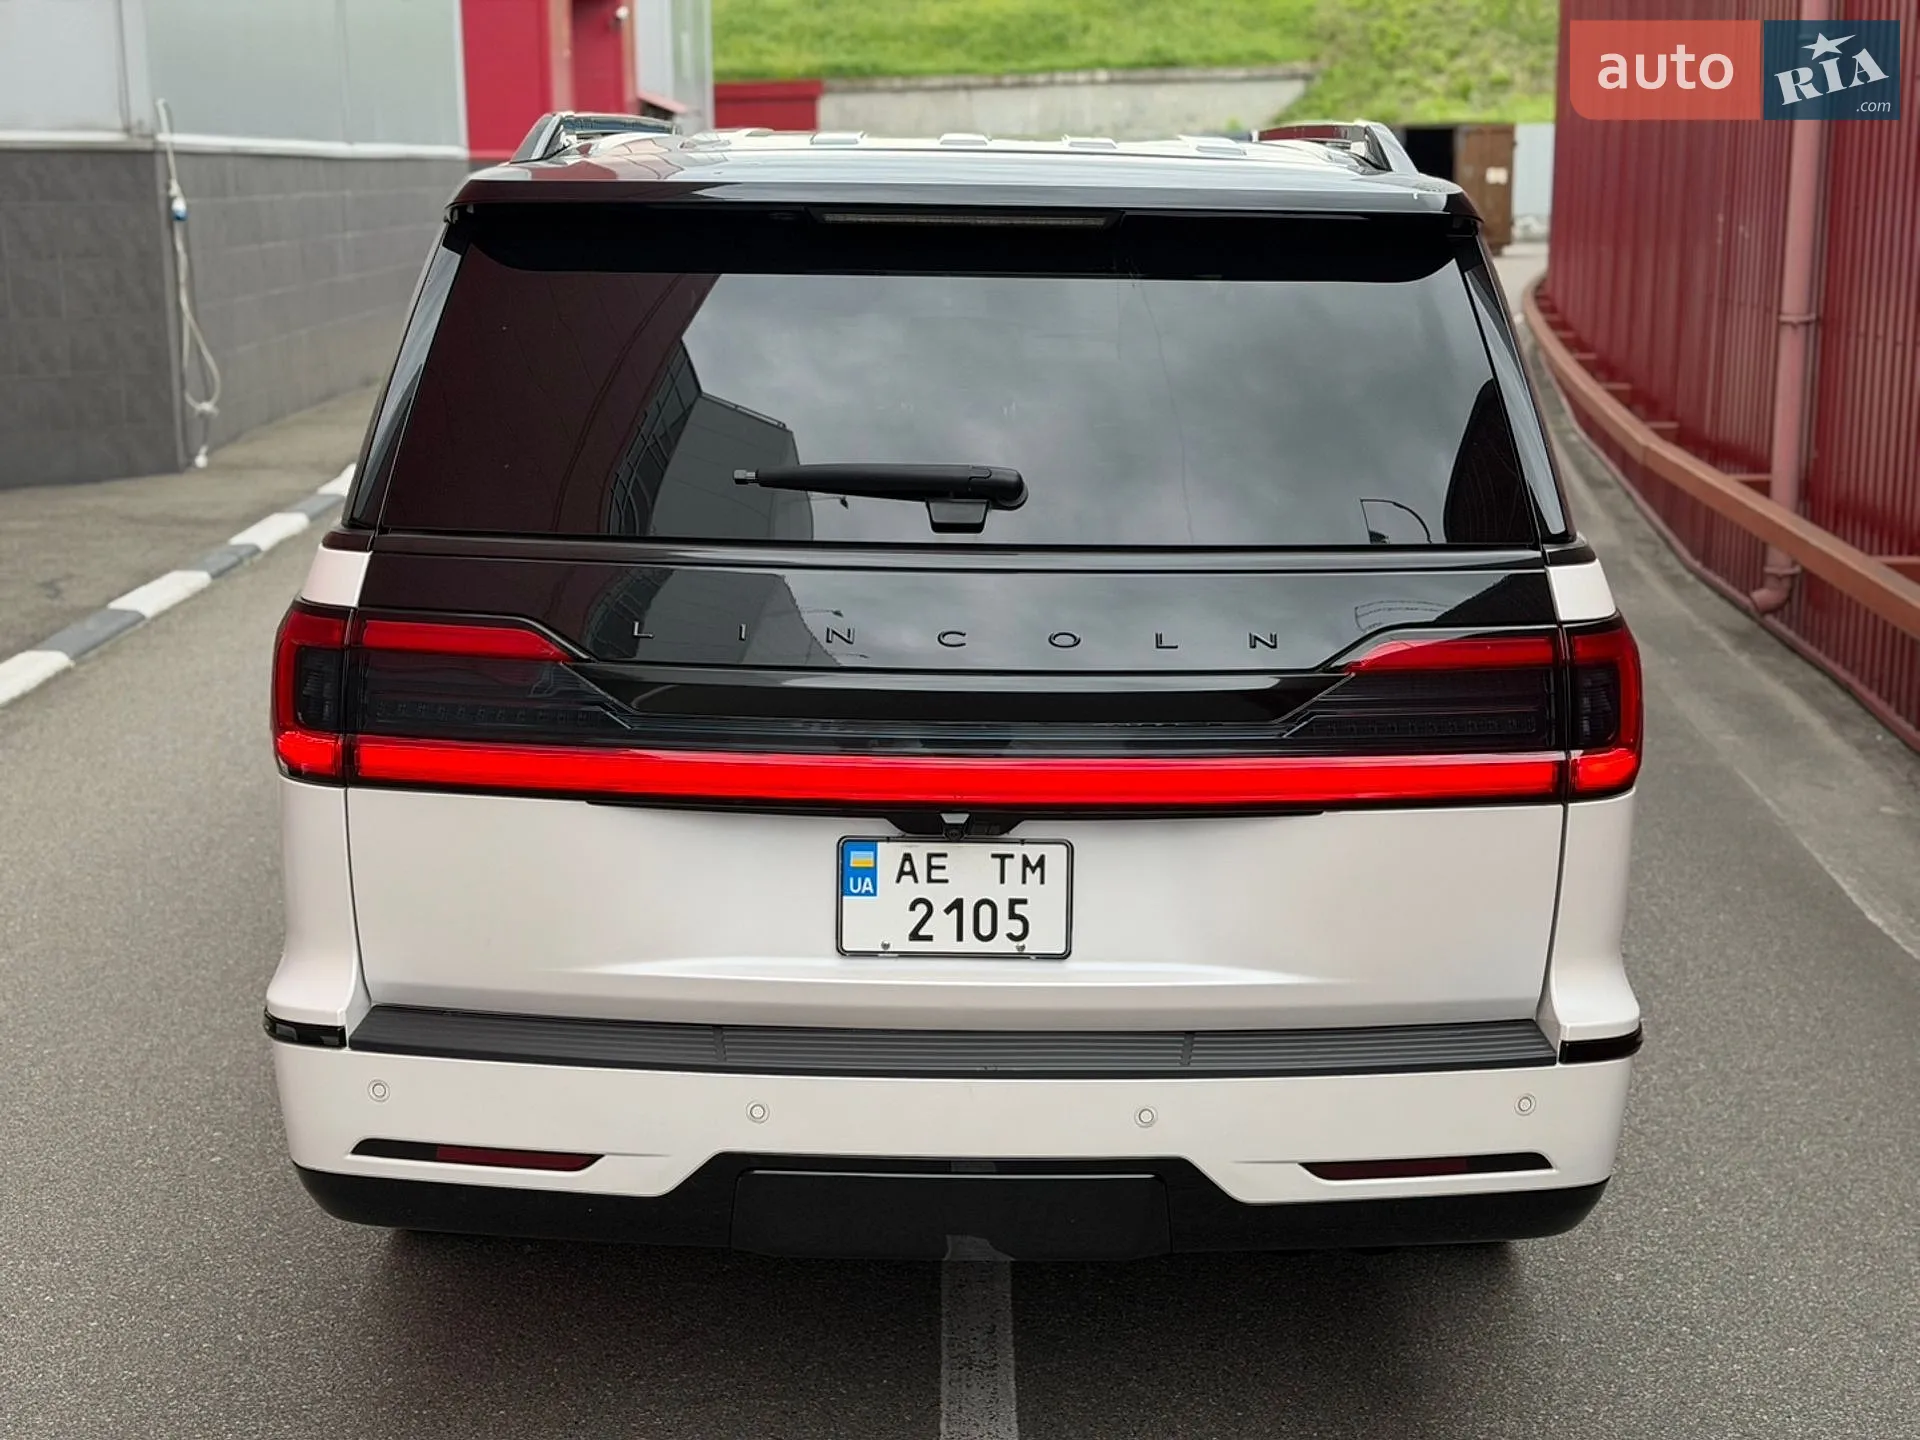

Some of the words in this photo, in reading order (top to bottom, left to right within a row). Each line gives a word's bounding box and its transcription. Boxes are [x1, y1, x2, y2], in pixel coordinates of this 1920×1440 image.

[632, 621, 1278, 650] LINCOLN
[895, 852, 949, 884] AE
[991, 853, 1046, 885] TM
[850, 877, 873, 894] UA
[908, 897, 1030, 943] 2105
